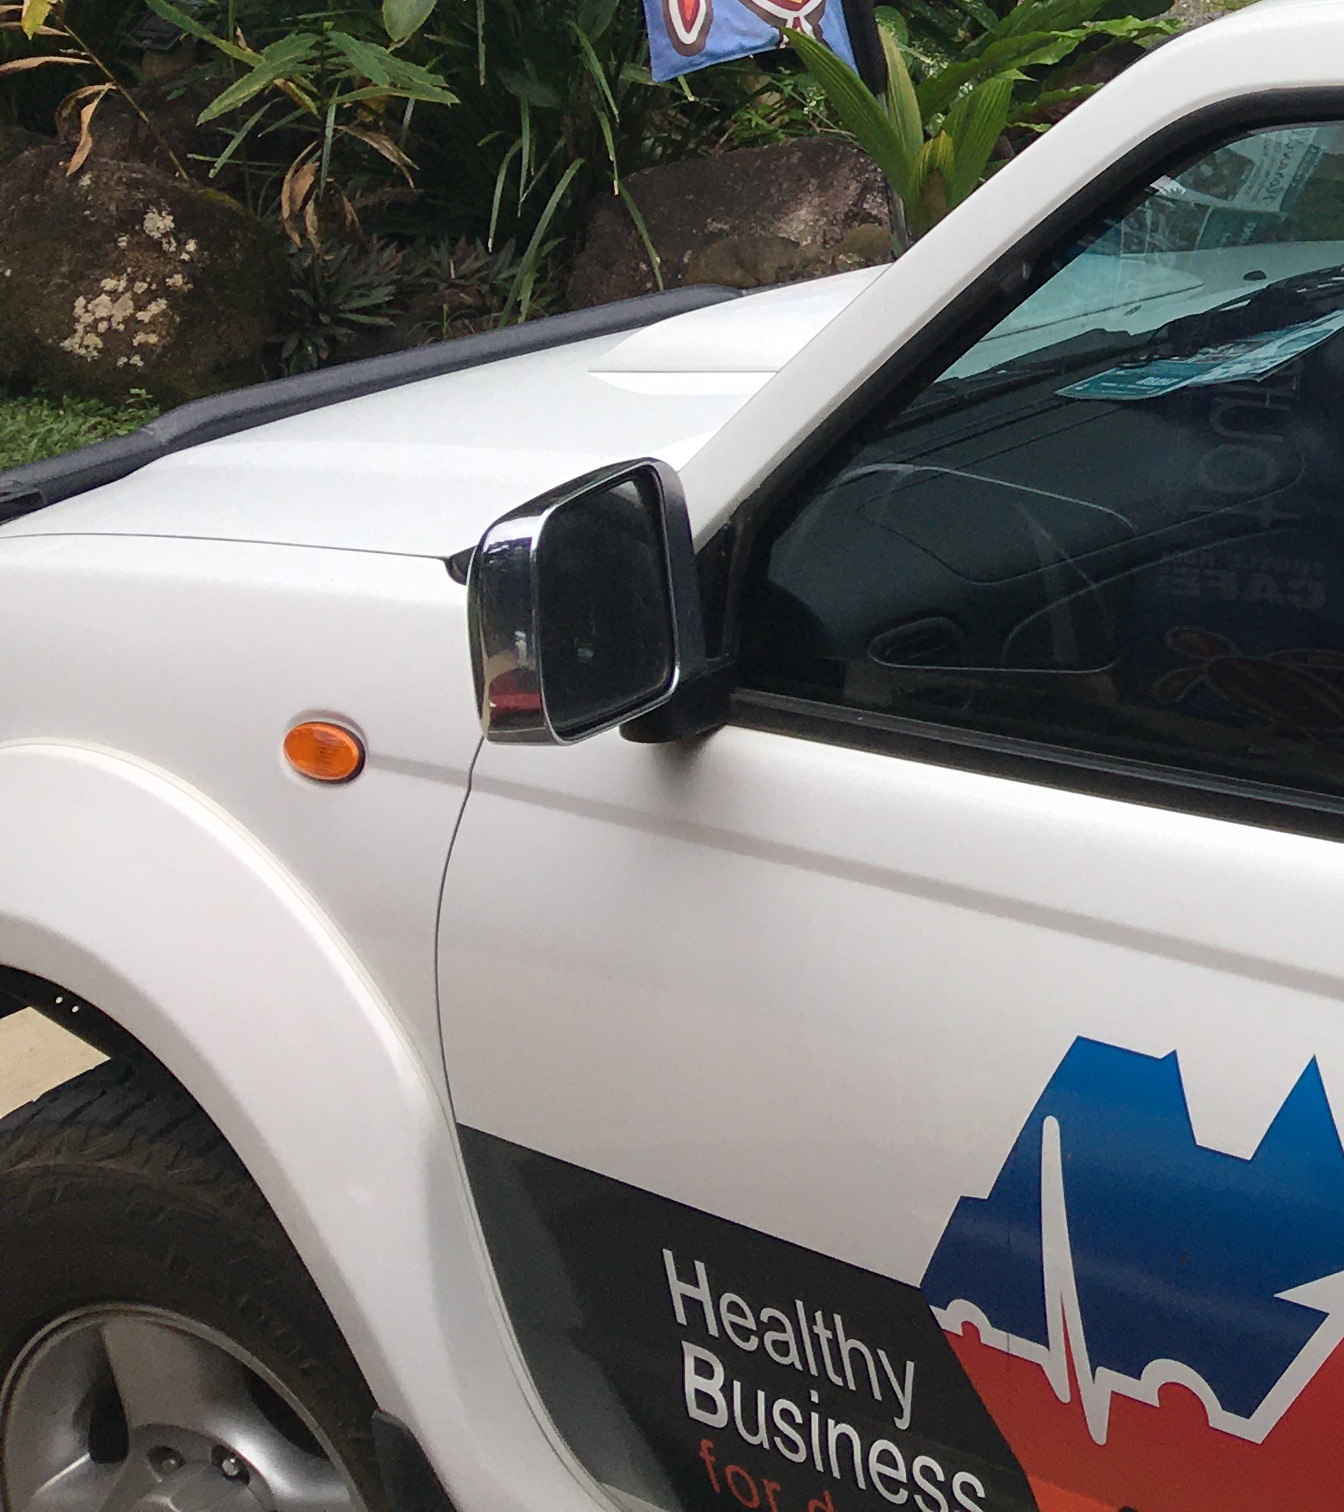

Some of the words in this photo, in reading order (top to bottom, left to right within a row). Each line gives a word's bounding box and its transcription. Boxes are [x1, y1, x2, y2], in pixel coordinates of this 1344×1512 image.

[661, 1248, 915, 1430] Healthy
[681, 1340, 986, 1512] Business
[700, 1439, 781, 1512] for
